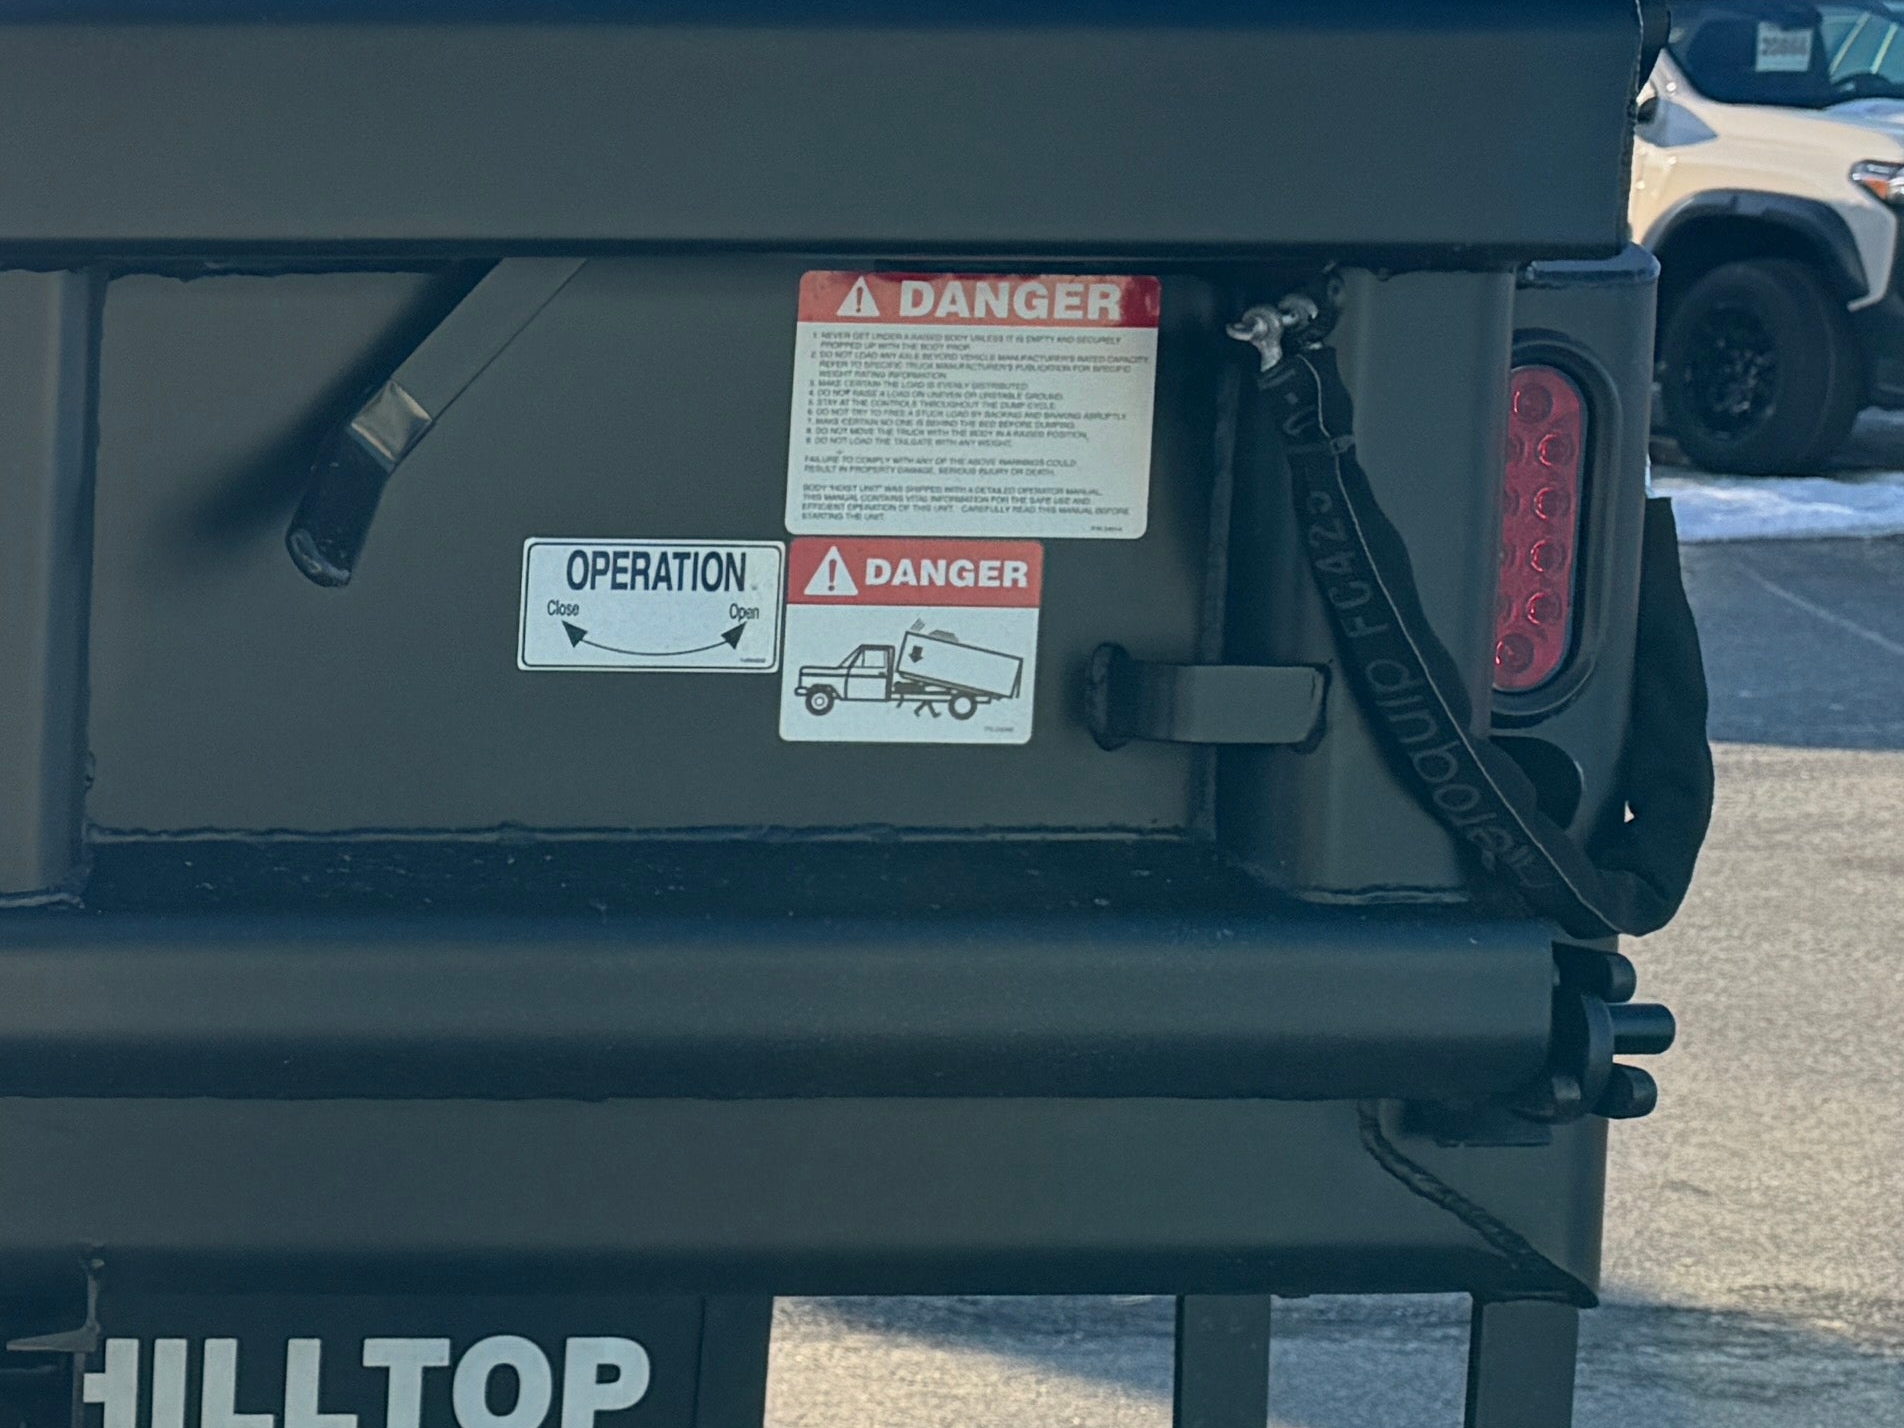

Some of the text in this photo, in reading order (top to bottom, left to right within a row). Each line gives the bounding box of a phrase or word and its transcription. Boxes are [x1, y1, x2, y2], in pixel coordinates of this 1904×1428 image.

[899, 281, 1122, 320] DANGER
[566, 549, 747, 592] OPERATION
[865, 558, 1028, 587] DANGER
[547, 599, 580, 616] Close
[729, 603, 759, 622] Open
